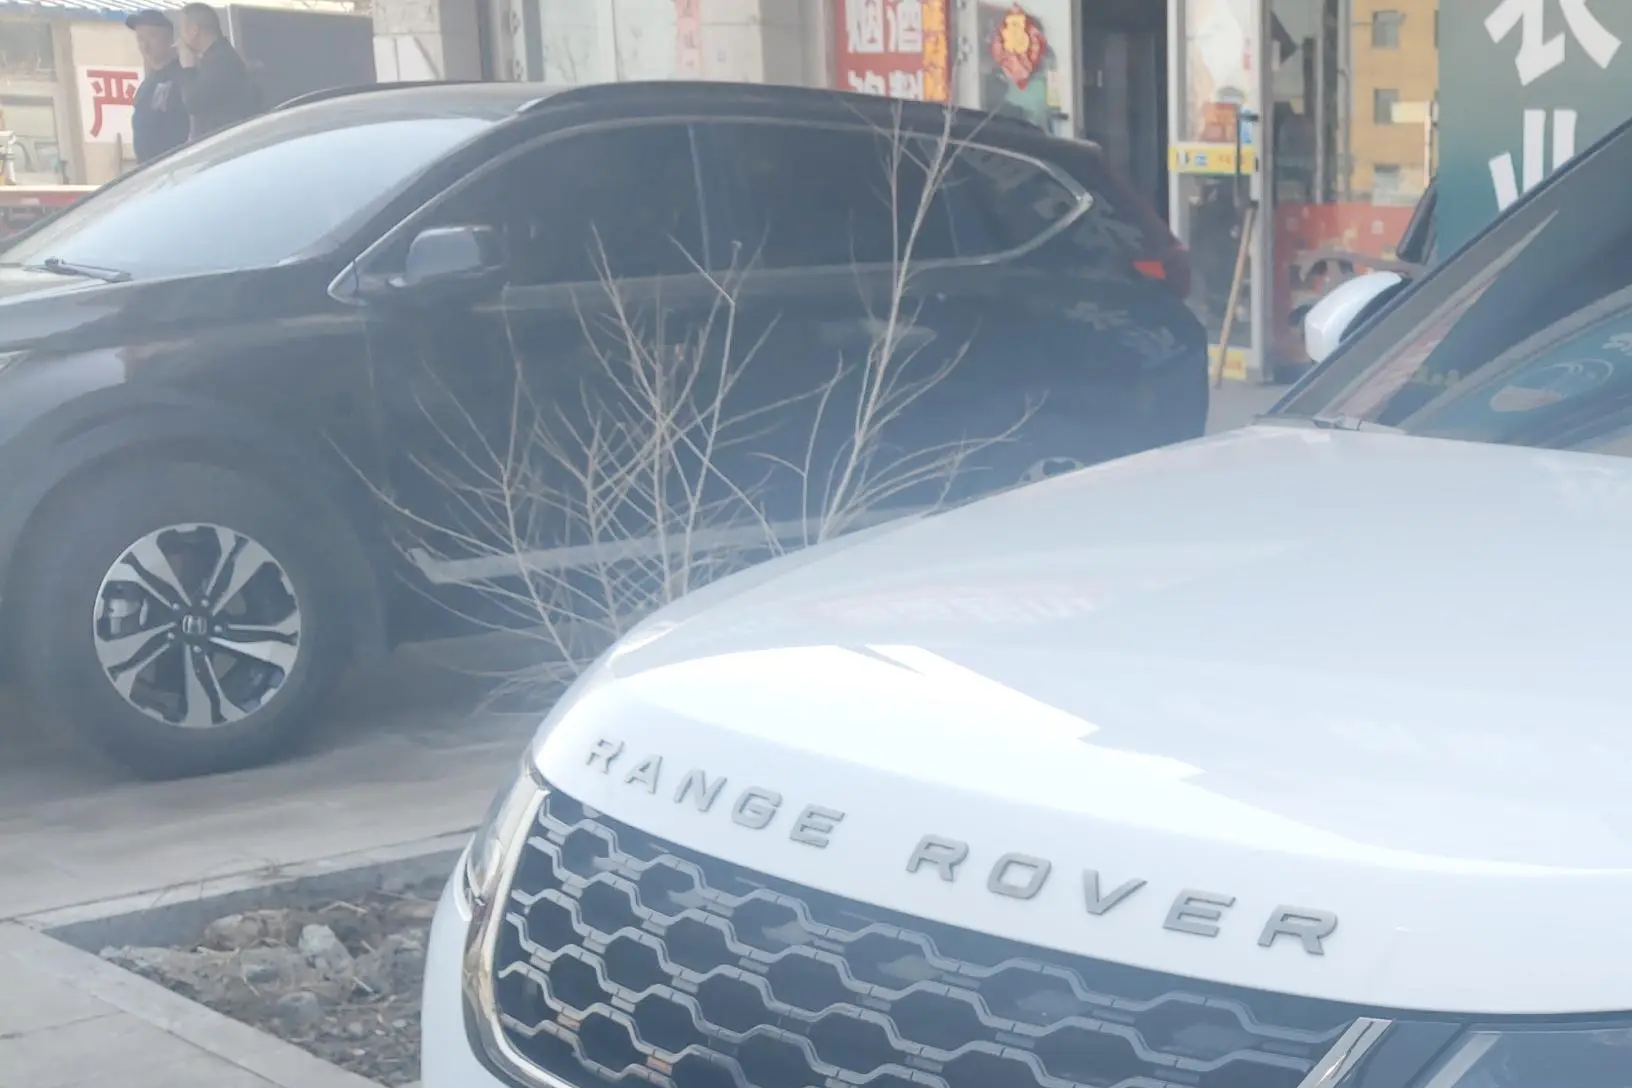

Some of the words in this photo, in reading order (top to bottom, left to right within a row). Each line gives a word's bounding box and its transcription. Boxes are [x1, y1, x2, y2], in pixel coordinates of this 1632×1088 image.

[87, 69, 138, 138] 严
[584, 737, 845, 849] RANGE
[905, 832, 1339, 956] ROVER
